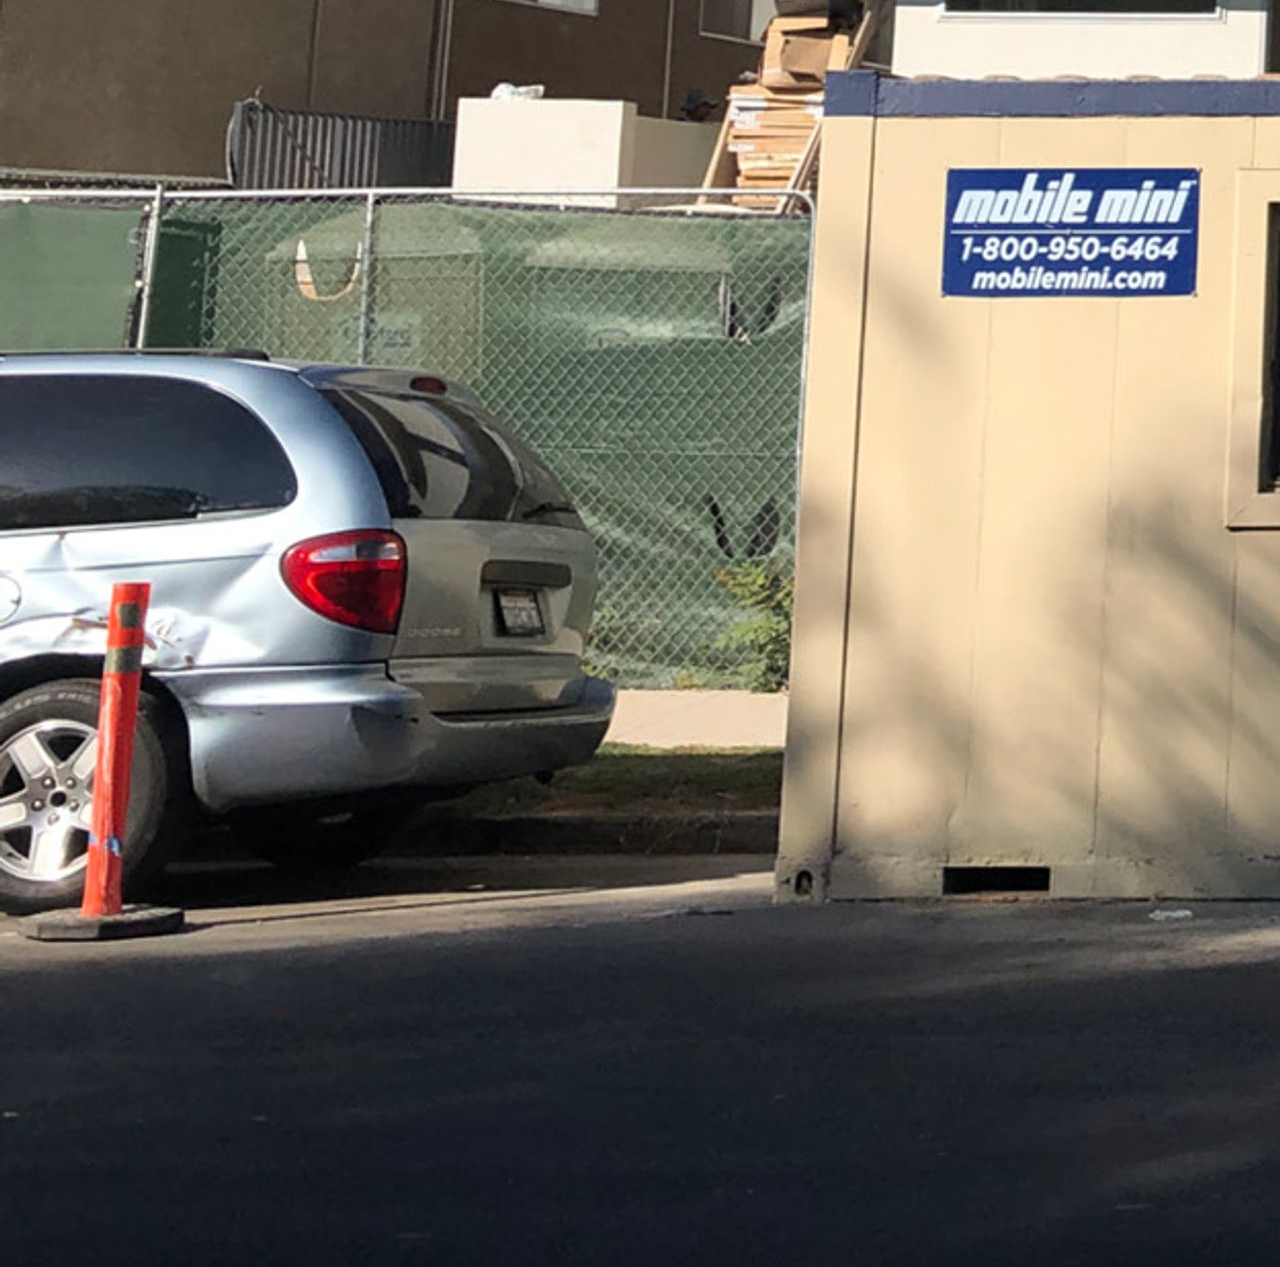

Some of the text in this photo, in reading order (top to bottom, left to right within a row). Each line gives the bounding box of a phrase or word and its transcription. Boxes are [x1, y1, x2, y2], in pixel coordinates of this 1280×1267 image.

[952, 172, 1191, 223] mobile mini
[961, 236, 1179, 261] 1-800-950-6464
[971, 266, 1166, 290] mobilemini.com
